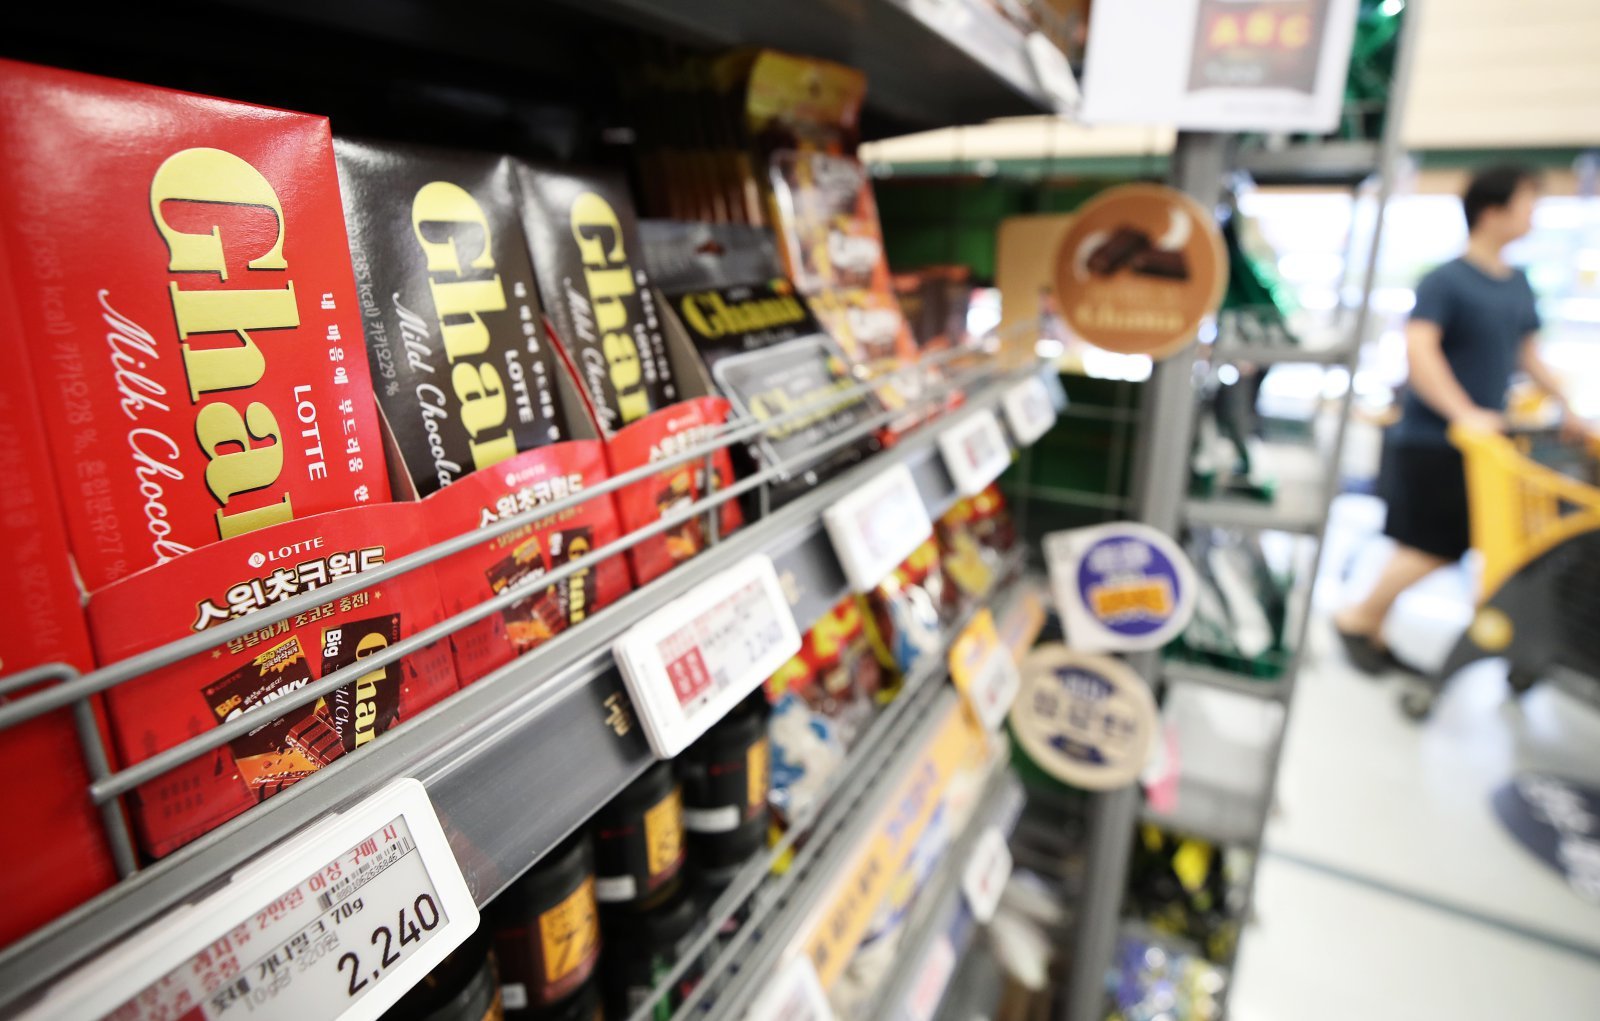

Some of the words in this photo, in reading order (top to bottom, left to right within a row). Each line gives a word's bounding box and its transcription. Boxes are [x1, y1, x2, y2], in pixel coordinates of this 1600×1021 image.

[321, 292, 336, 310] 내
[392, 292, 436, 374] Mild
[97, 288, 172, 422] Milk
[327, 323, 349, 385] 마음에
[504, 350, 535, 424] LOTTE
[294, 384, 328, 481] LOTTE
[338, 398, 364, 473] 부드러운
[128, 427, 195, 564] Chocol
[268, 536, 324, 562] LOTTE
[339, 591, 369, 613] 충전!
[324, 628, 342, 658] Big
[308, 861, 343, 893] 이상
[348, 837, 379, 866] 구매
[383, 824, 398, 844] 시
[331, 897, 364, 925] 70g
[337, 893, 441, 999] 2,240
